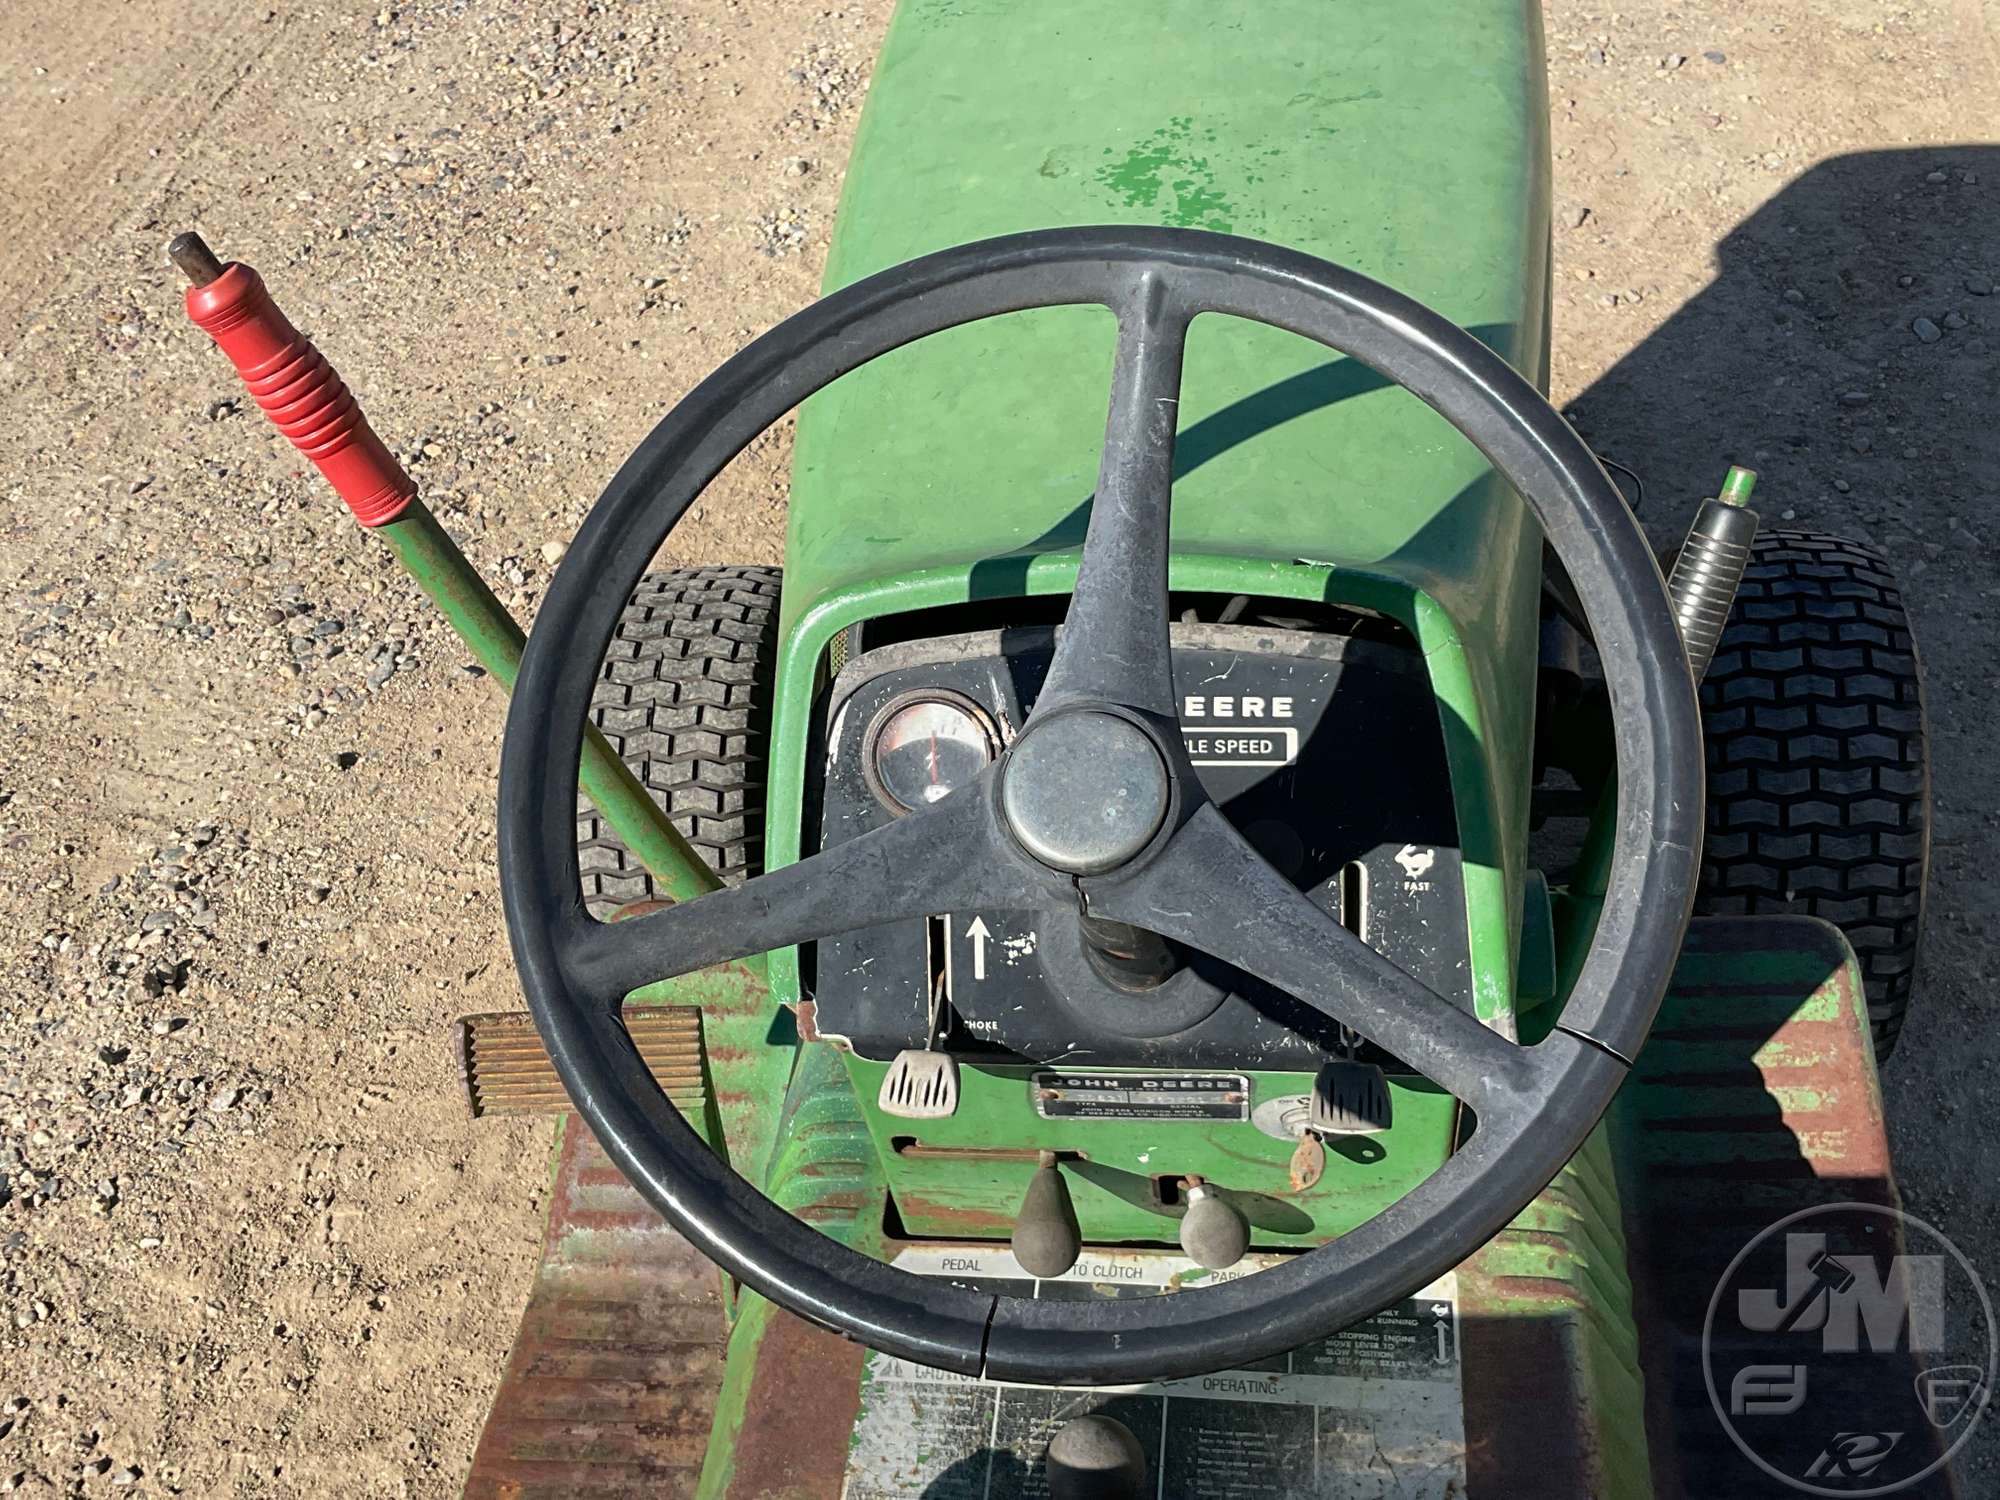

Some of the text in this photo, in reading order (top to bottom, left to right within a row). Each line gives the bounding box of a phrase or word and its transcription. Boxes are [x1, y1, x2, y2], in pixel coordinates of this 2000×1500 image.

[1183, 696, 1293, 718] EERE
[1185, 739, 1273, 754] LE SPEED
[1403, 881, 1430, 891] FAST
[1052, 1078, 1119, 1088] JOHN
[1142, 1080, 1231, 1089] DEERE
[942, 1259, 982, 1272] PEDAL
[1071, 1264, 1088, 1276] TO
[1383, 1335, 1416, 1343] ENGINE
[1203, 1377, 1278, 1394] OPERATING
